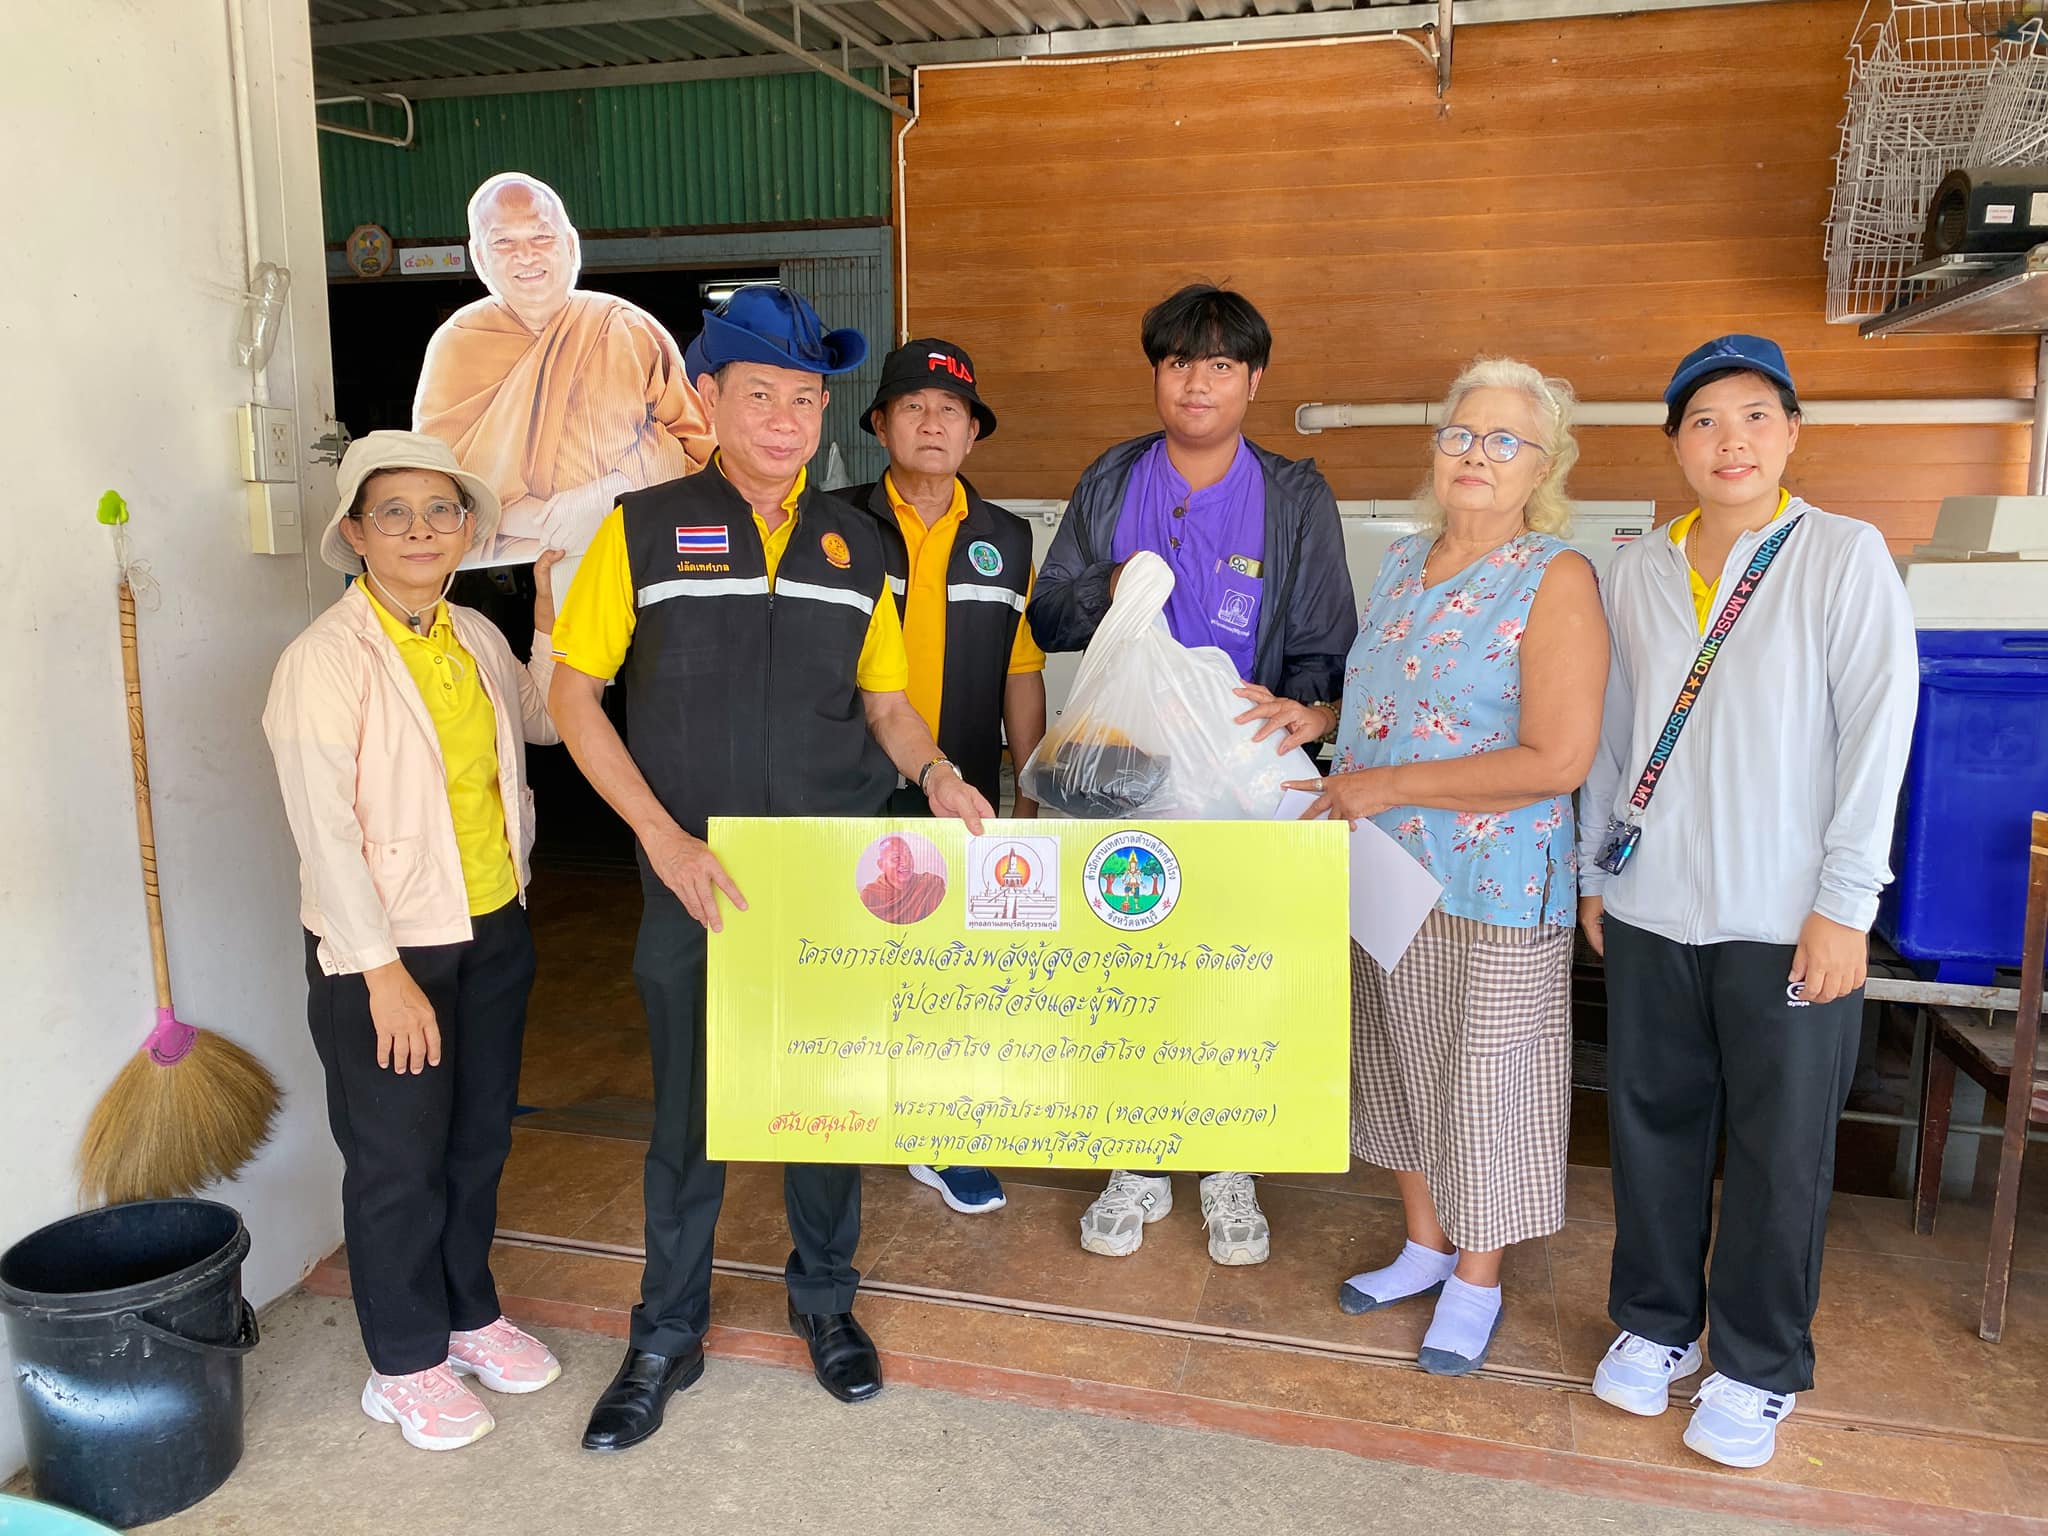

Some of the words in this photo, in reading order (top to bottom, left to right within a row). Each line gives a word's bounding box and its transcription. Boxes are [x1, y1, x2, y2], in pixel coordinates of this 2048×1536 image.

[1694, 595, 1747, 676] MOSCHINO
[1649, 691, 1697, 770] MOSCHINO
[798, 932, 1191, 982] โครงการเยี่ยมเสริมพลังผู้สูงอายุติดบ้าน
[1195, 942, 1274, 971] ติดเตียง
[892, 977, 1161, 1025] ผู้ป่วยโรคเรื้อรังและผู้พิการ
[787, 1033, 991, 1062] เทศบาลตำบลโคกสำโรง
[997, 1036, 1147, 1063] อำเภอโคกสำโรง
[1152, 1040, 1280, 1074] จังหวัดลพบุรี
[768, 1109, 880, 1144] สนับสนุนโดย
[894, 1131, 1184, 1164] และพุทธสถานลพบุรีศรีสุวรรณภูมิ
